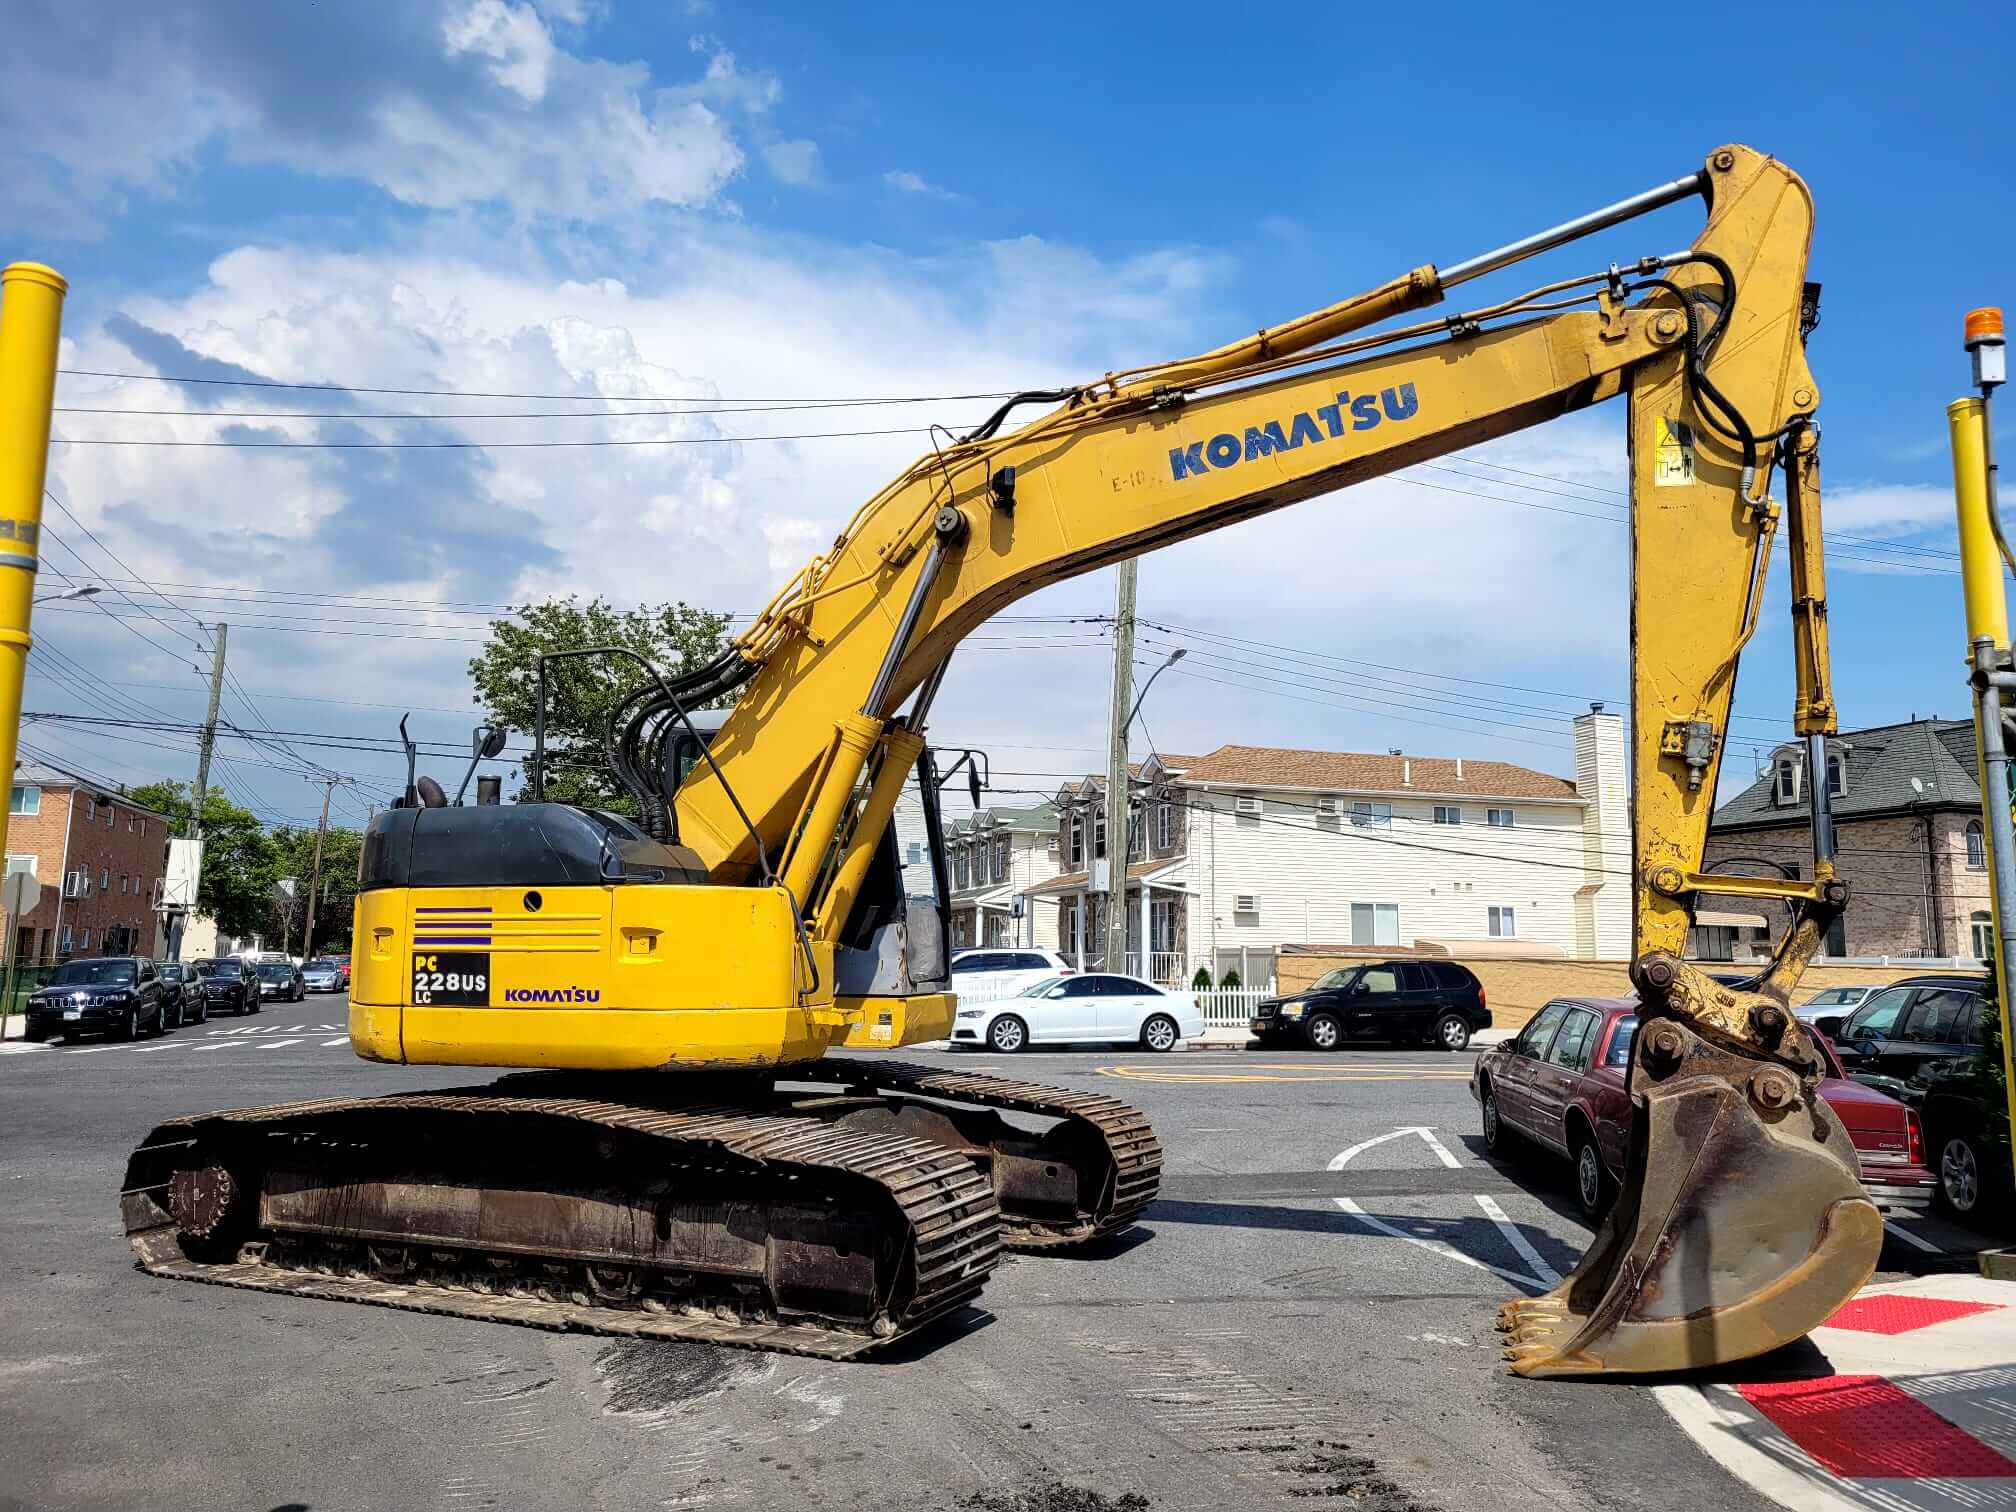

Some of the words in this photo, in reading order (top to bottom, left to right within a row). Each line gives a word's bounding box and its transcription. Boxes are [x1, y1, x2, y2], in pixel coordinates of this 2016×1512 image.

[1168, 382, 1419, 480] KOMATSU
[415, 956, 437, 971] PC
[415, 973, 486, 991] 228US
[415, 991, 431, 1003] LC
[505, 985, 600, 1002] KOMATSU
